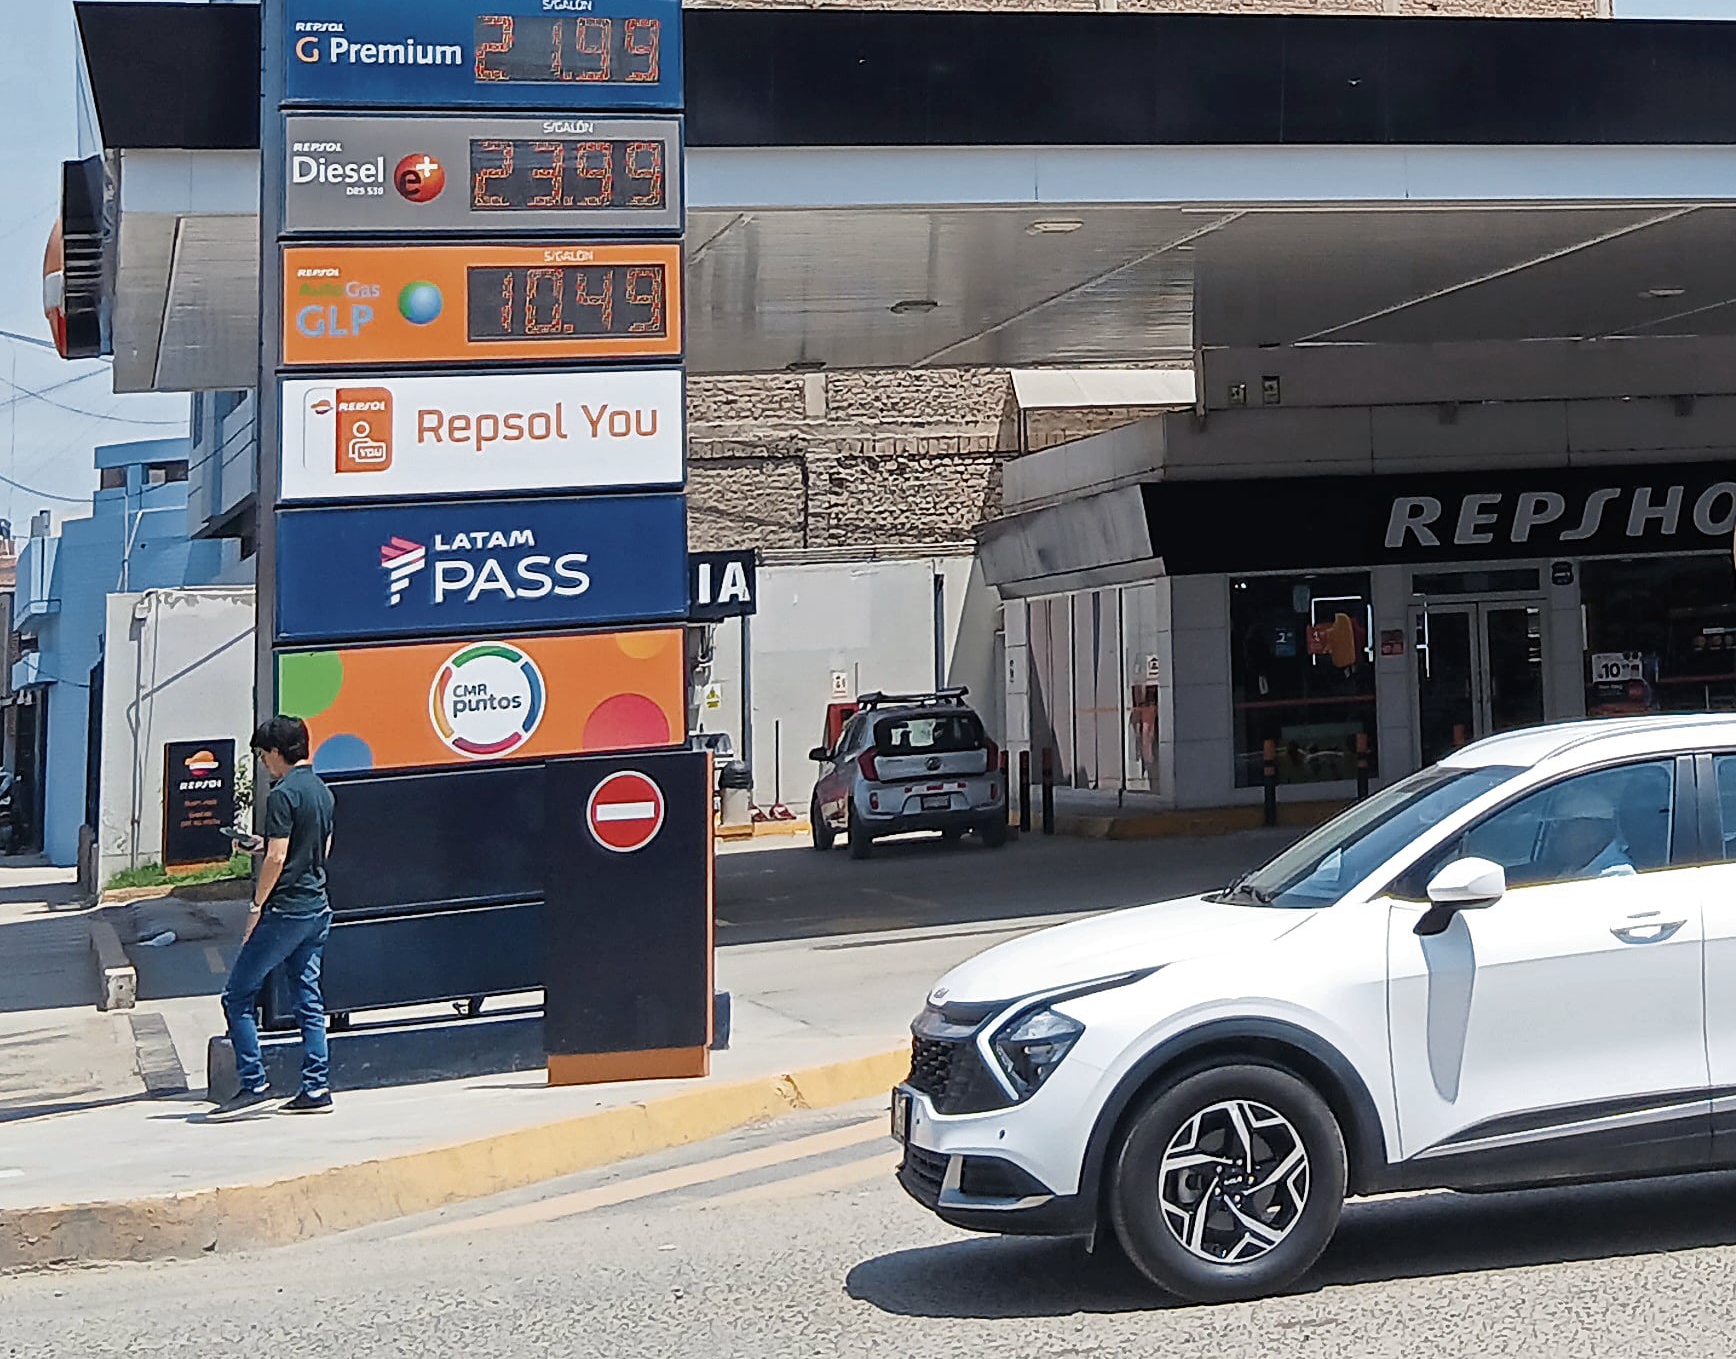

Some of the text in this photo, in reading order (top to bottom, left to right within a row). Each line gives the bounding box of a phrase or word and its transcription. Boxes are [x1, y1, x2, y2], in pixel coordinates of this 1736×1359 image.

[295, 22, 345, 32] REPSOL
[295, 36, 462, 65] G Premium
[293, 142, 342, 152] REPSOL
[292, 155, 384, 184] Diesel
[475, 141, 662, 206] 23.99
[501, 268, 662, 334] 10.49
[296, 304, 374, 339] GLP
[339, 401, 386, 411] REPSOL
[416, 403, 658, 452] Repsol You
[434, 529, 535, 552] LATAM
[433, 553, 591, 604] PASS
[453, 684, 488, 698] CMR
[453, 693, 522, 719] puntos
